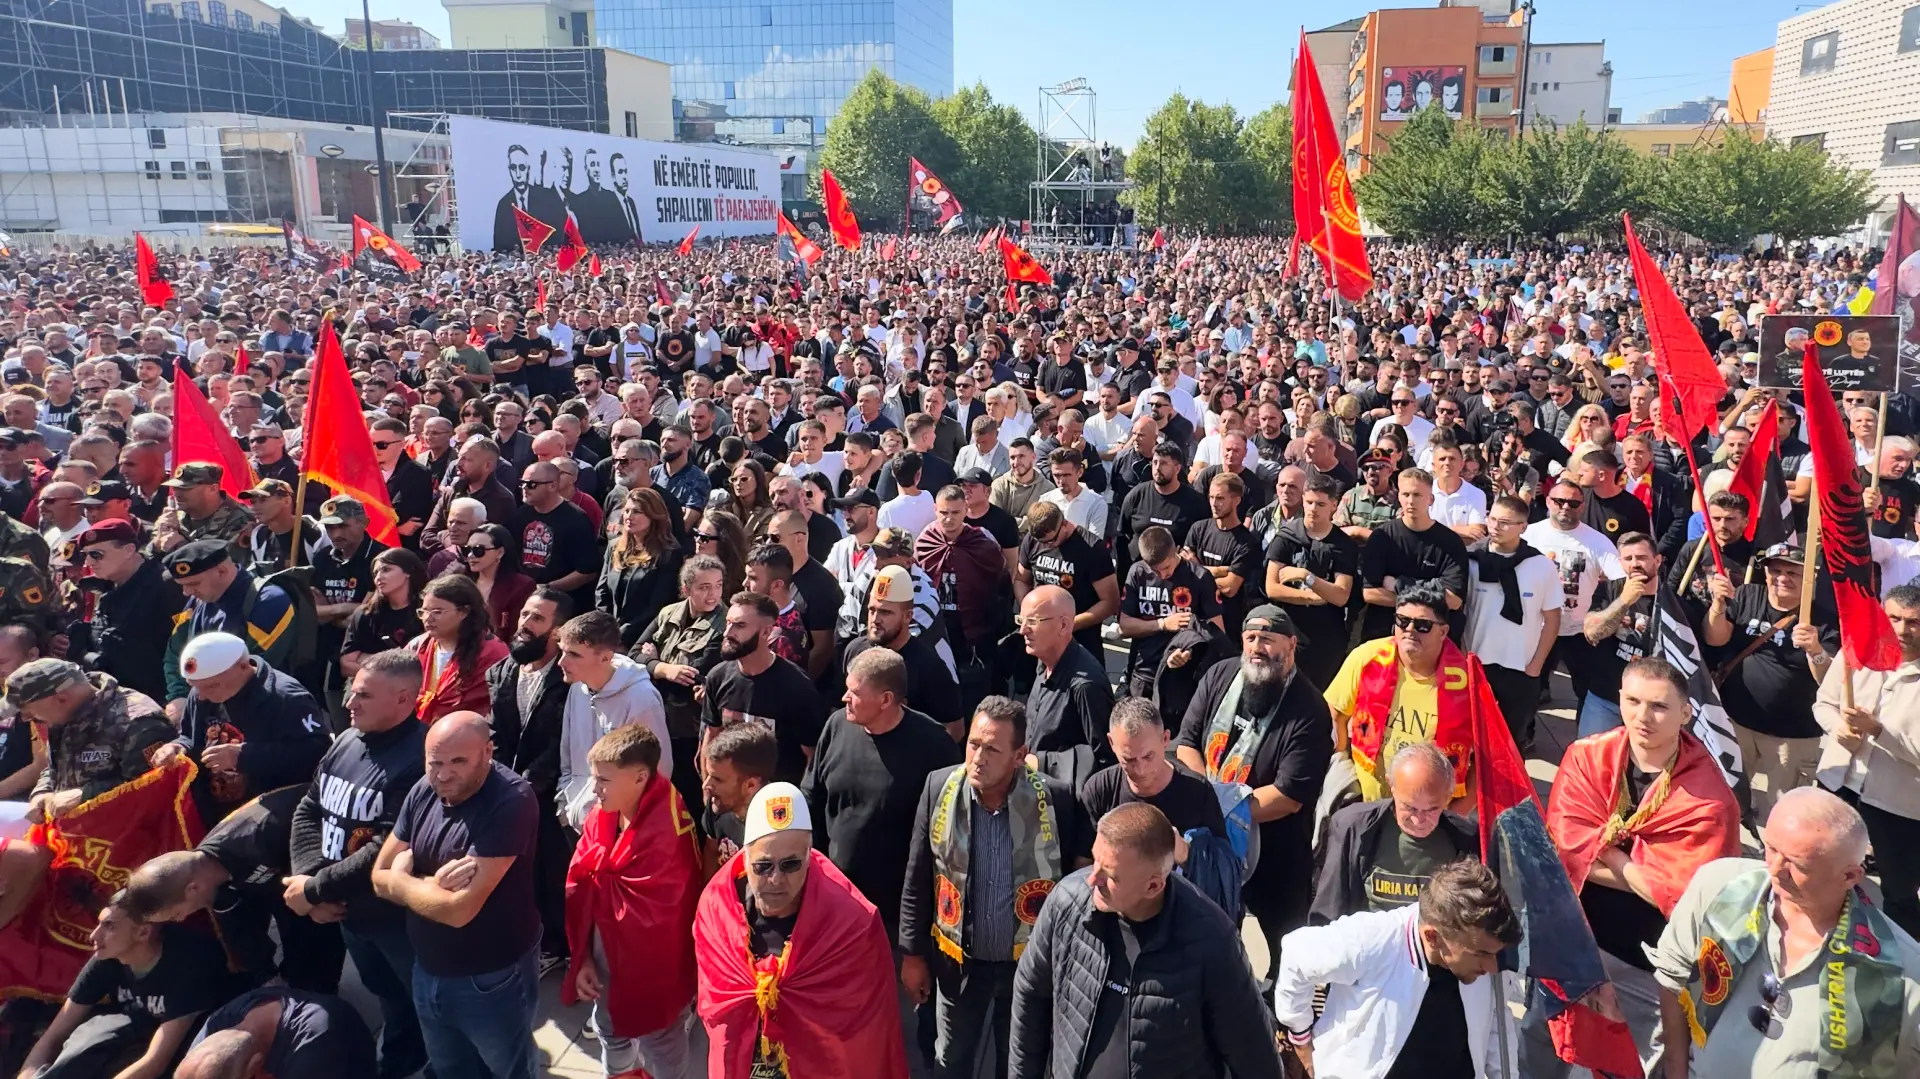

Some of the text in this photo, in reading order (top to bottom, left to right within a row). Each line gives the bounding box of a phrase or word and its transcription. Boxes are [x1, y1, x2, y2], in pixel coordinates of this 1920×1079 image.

[654, 154, 759, 192] NË EMËR TË POPULLIT,
[657, 193, 777, 223] SHPALLENI TË PAFAJSHËM!
[1036, 555, 1075, 575] LIRIA KA
[1139, 586, 1169, 602] LIRIA
[1139, 602, 1155, 616] KA
[351, 786, 384, 822] KA
[932, 780, 957, 844] USHTRIA
[1375, 878, 1419, 897] LIRIA KA
[1106, 979, 1129, 995] Keep
[147, 995, 166, 1015] KA
[1828, 961, 1847, 1050] USHTRIA
